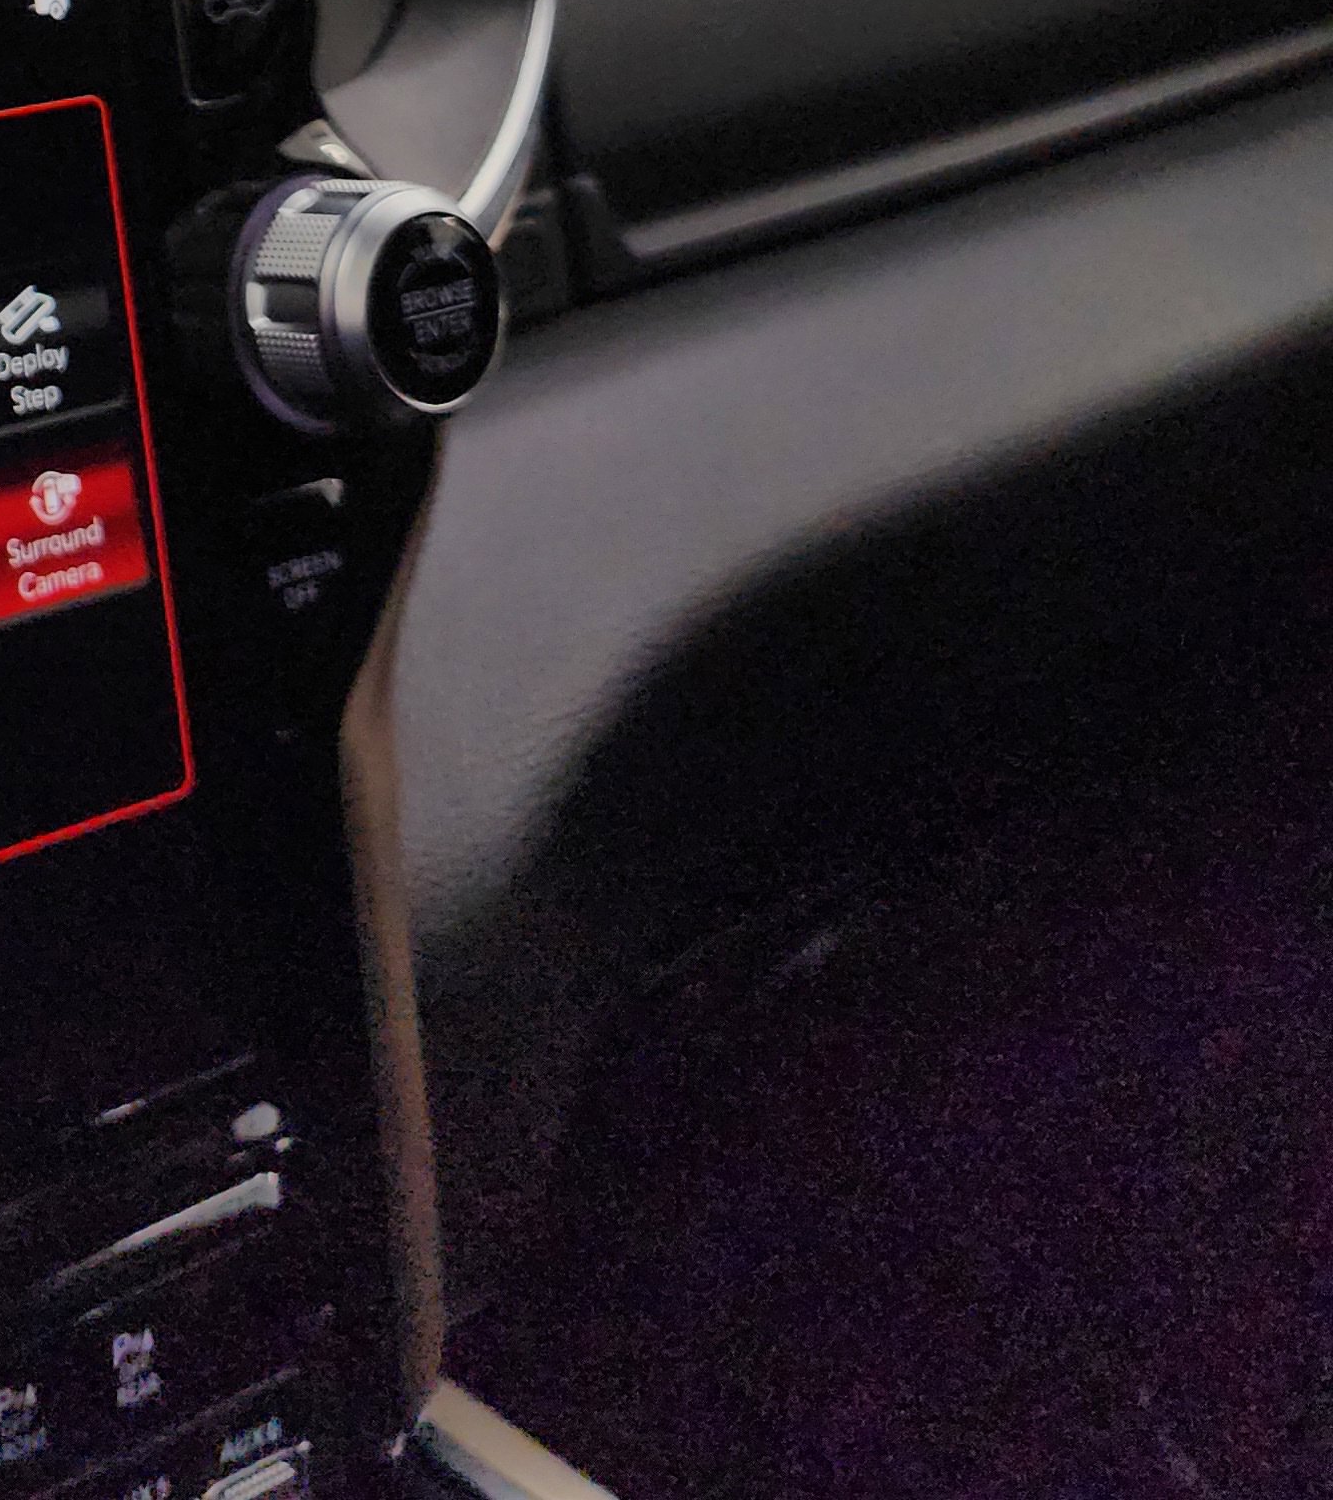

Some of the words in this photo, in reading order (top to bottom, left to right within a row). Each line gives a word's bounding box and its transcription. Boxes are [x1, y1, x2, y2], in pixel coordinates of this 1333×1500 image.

[11, 386, 62, 416] Step
[6, 516, 106, 569] Surround
[17, 560, 103, 601] Camera
